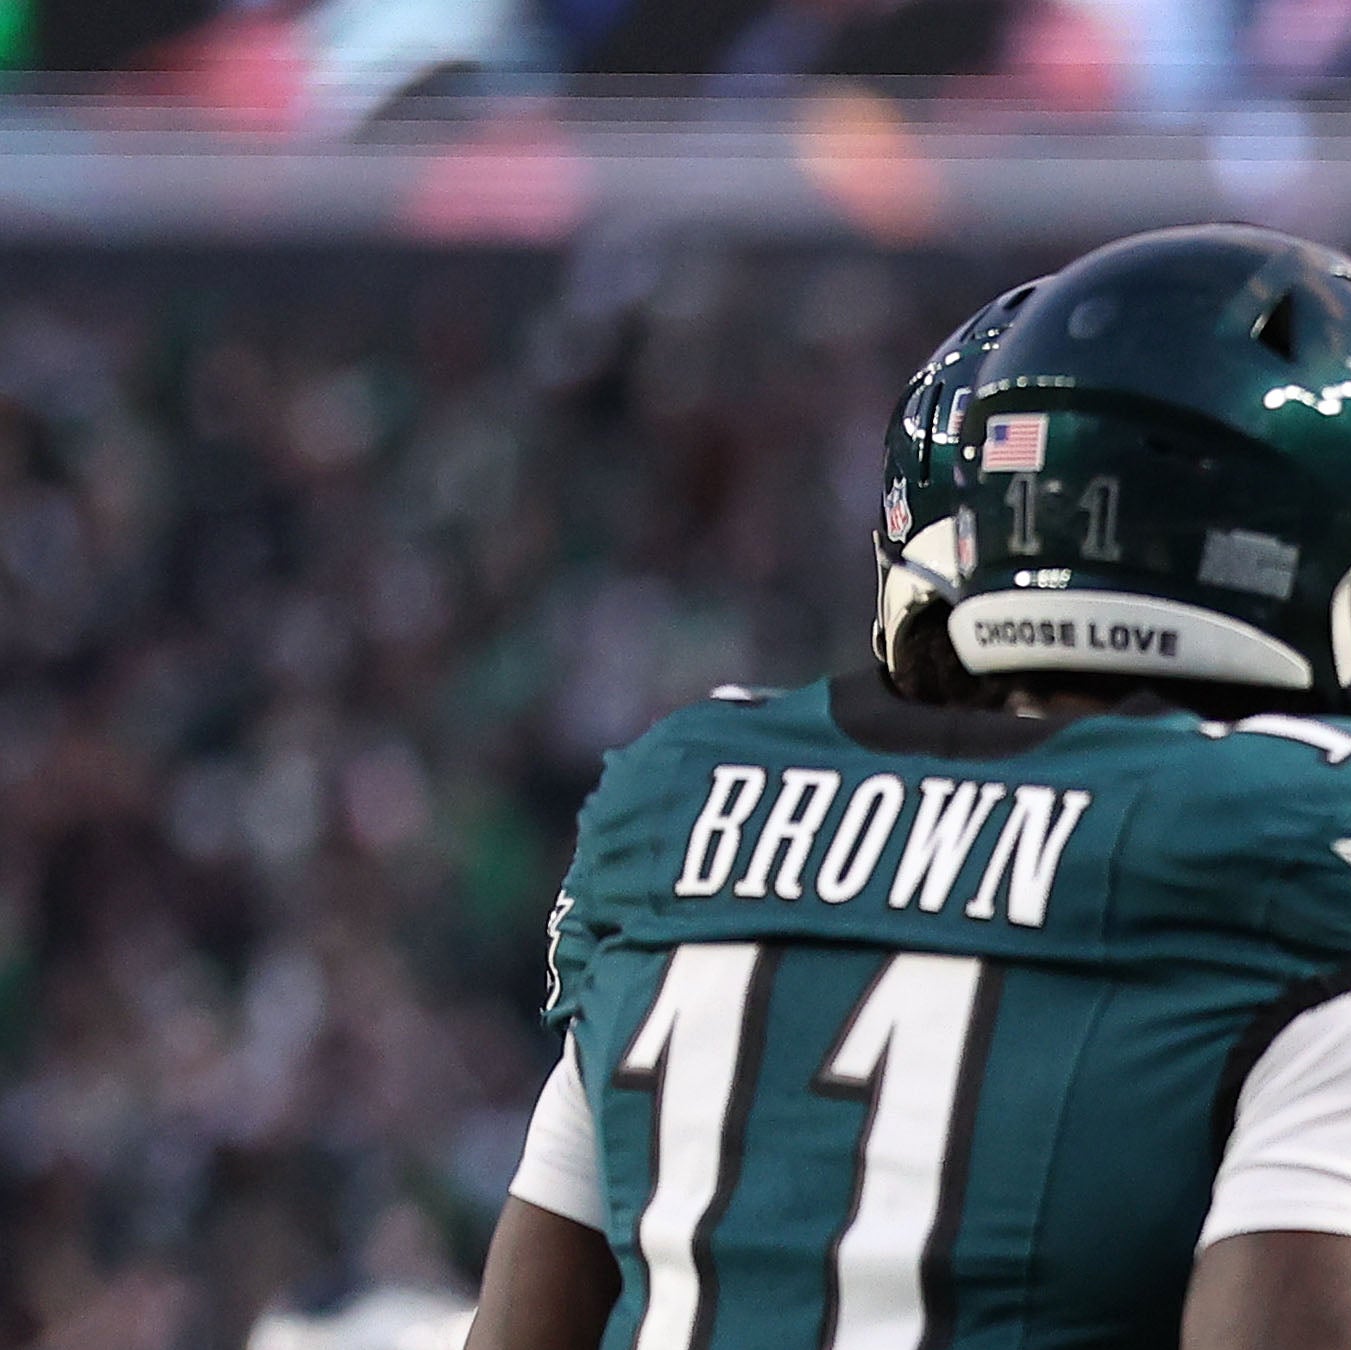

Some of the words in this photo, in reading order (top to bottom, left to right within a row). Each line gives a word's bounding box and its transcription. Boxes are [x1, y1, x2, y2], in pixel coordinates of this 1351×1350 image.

[974, 620, 1076, 649] CHOOSE
[1088, 621, 1179, 657] LOVE
[674, 763, 1092, 929] BROWN
